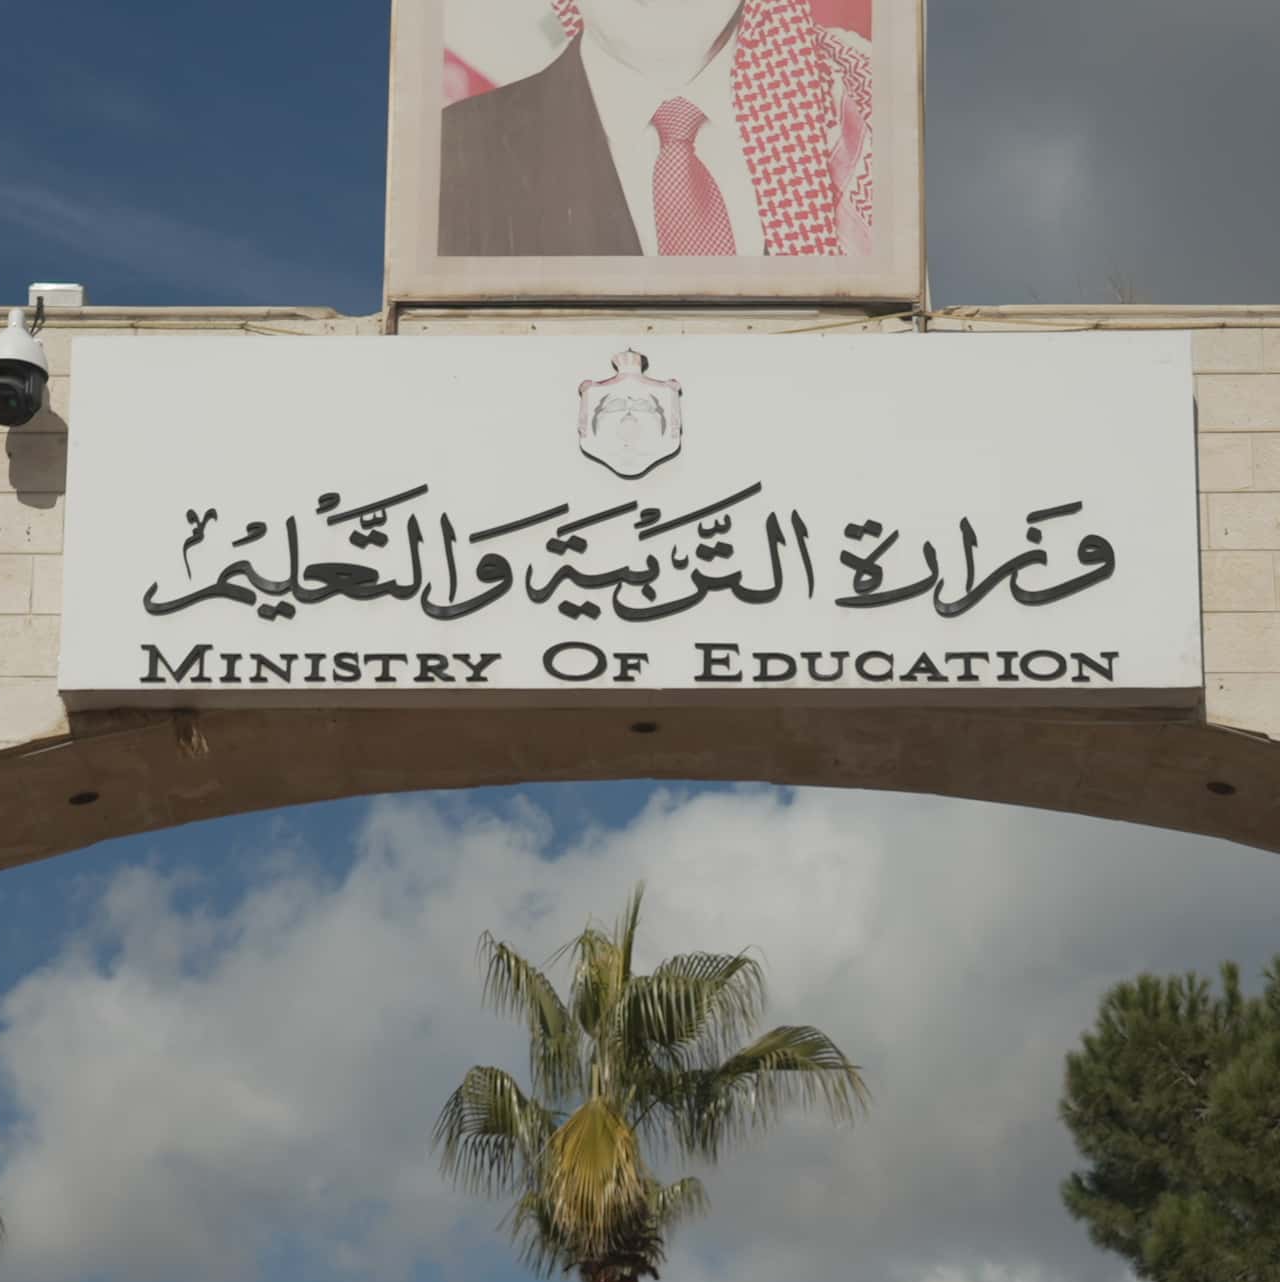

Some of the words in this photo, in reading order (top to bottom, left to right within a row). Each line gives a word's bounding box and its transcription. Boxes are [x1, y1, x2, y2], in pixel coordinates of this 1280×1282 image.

[139, 644, 502, 684] MINISTRY
[542, 641, 649, 682] OF
[694, 642, 1119, 683] EDUCATION
